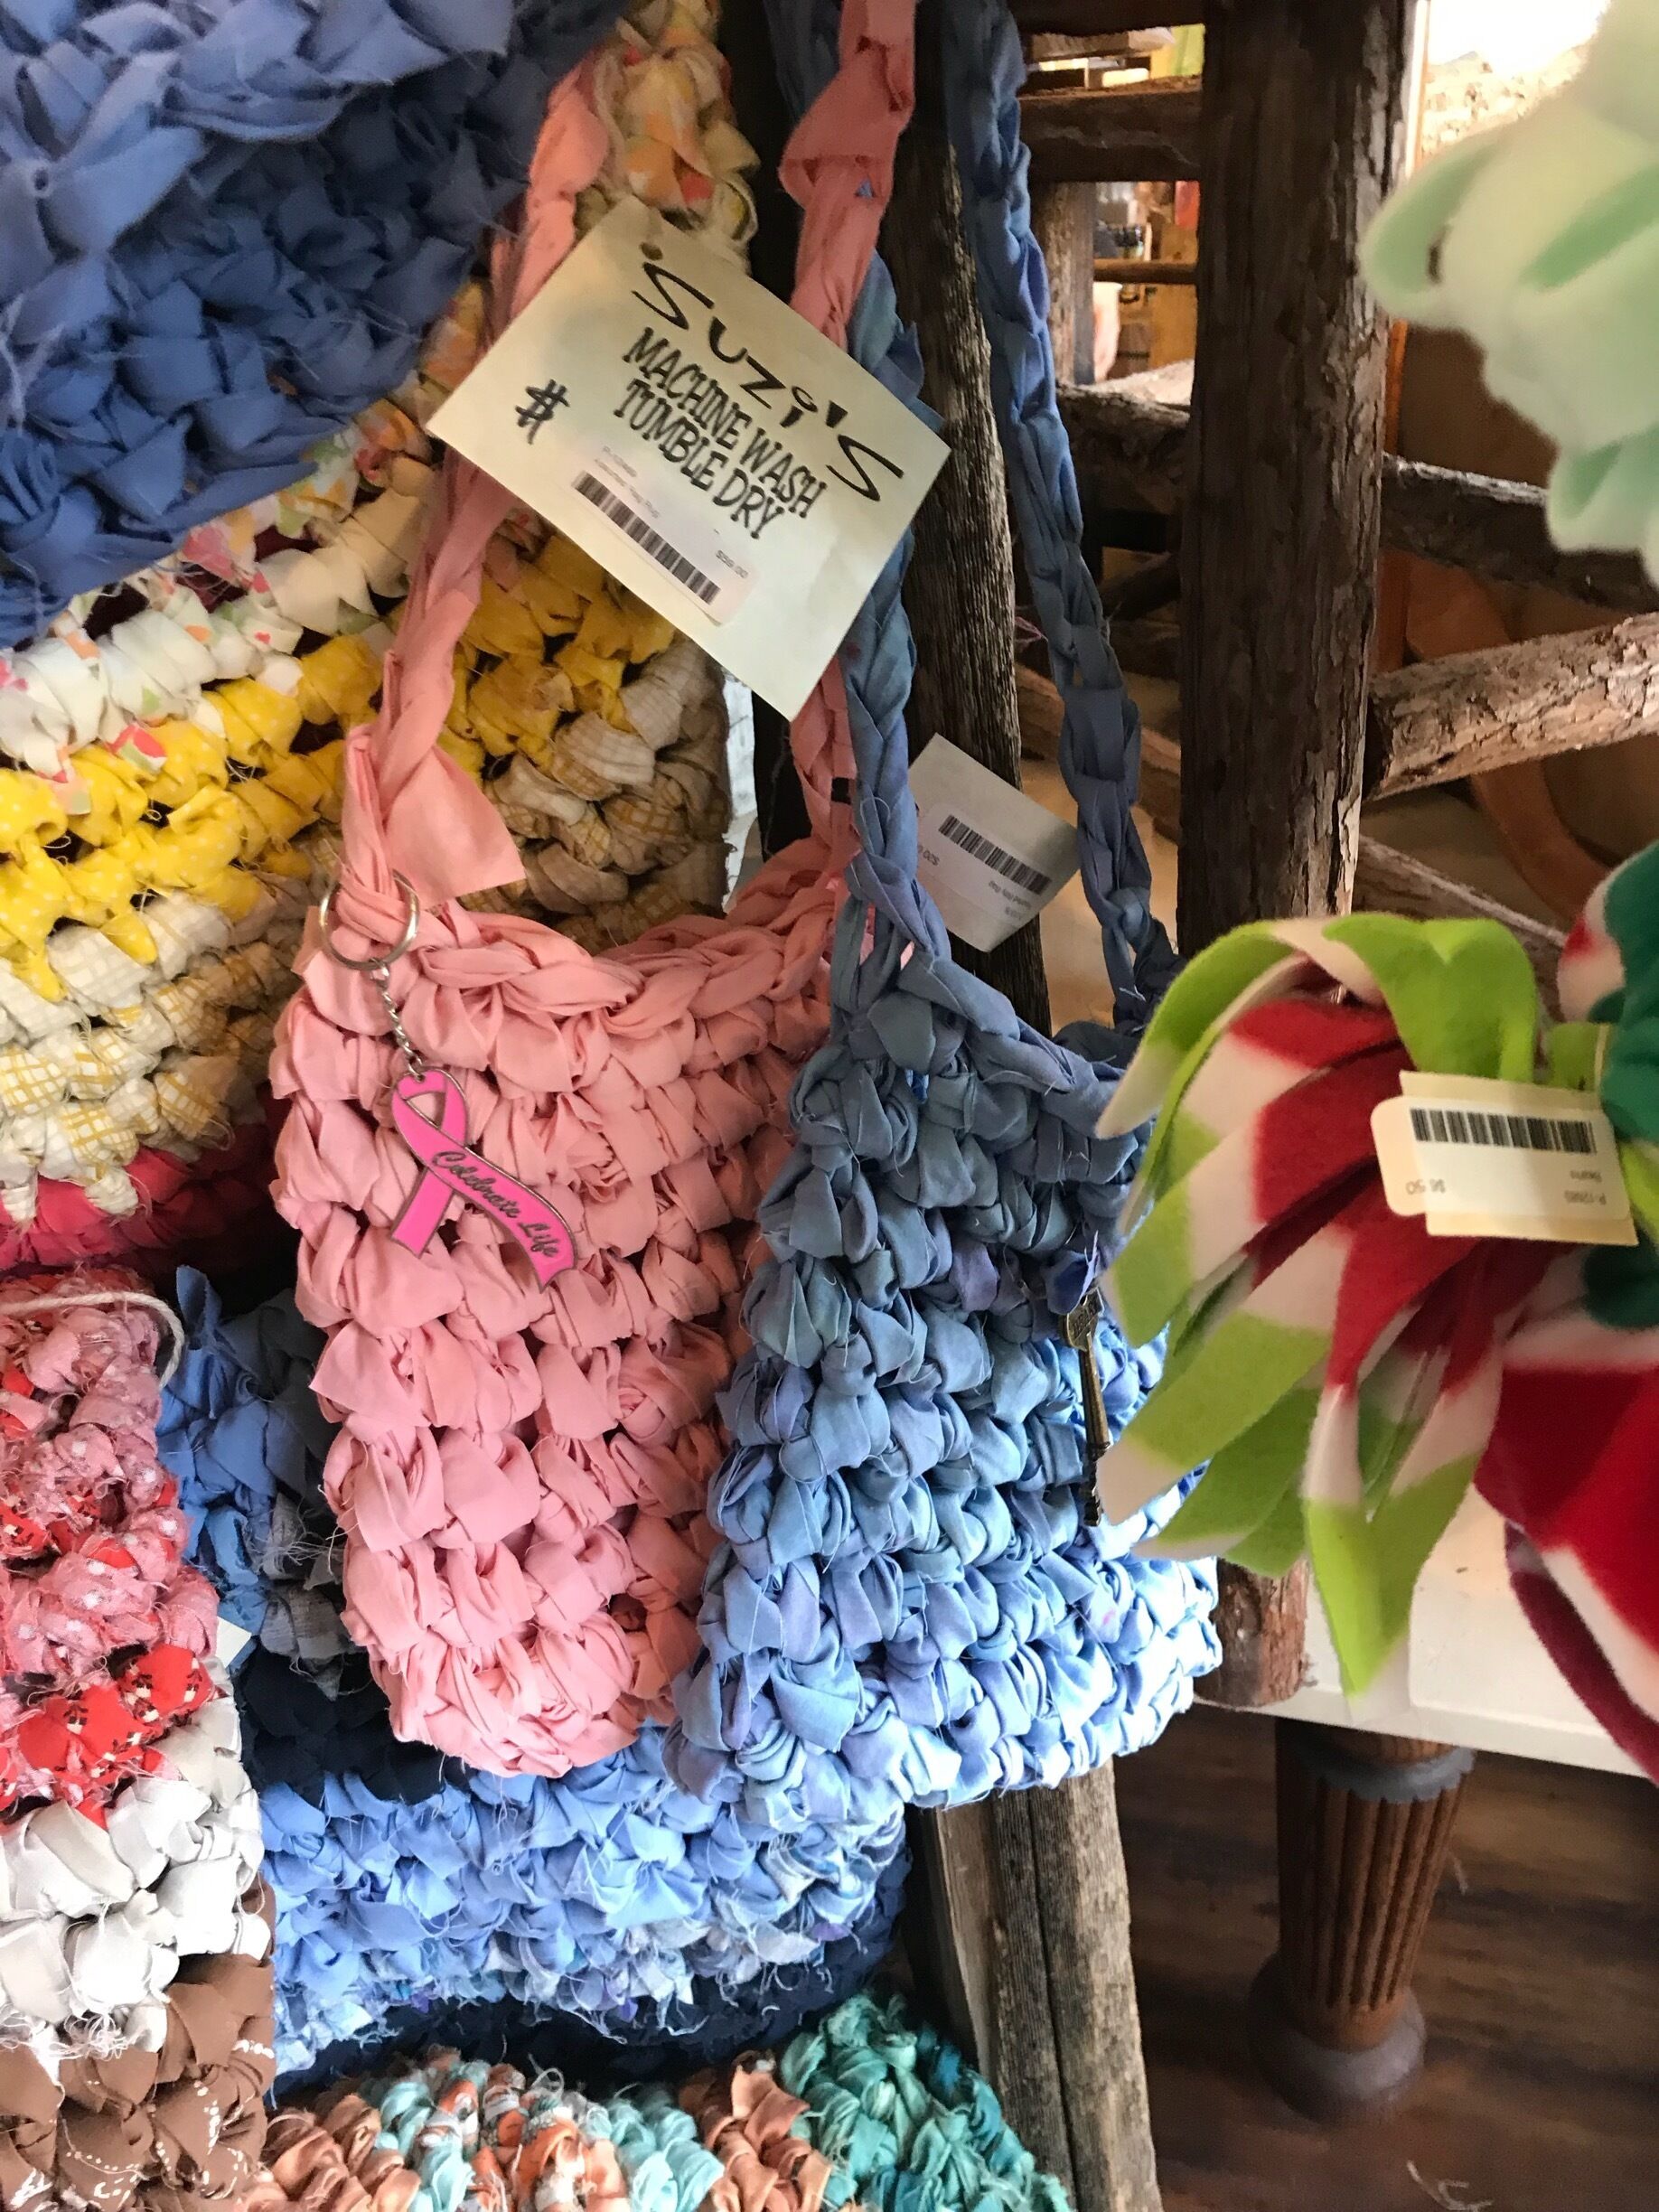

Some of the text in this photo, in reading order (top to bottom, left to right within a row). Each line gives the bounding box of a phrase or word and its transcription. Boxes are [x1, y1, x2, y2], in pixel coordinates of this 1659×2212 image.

[614, 379, 784, 539] TUMBLE DRY
[623, 327, 827, 519] MACHINE WASH
[431, 1151, 559, 1258] Celebrate Life
